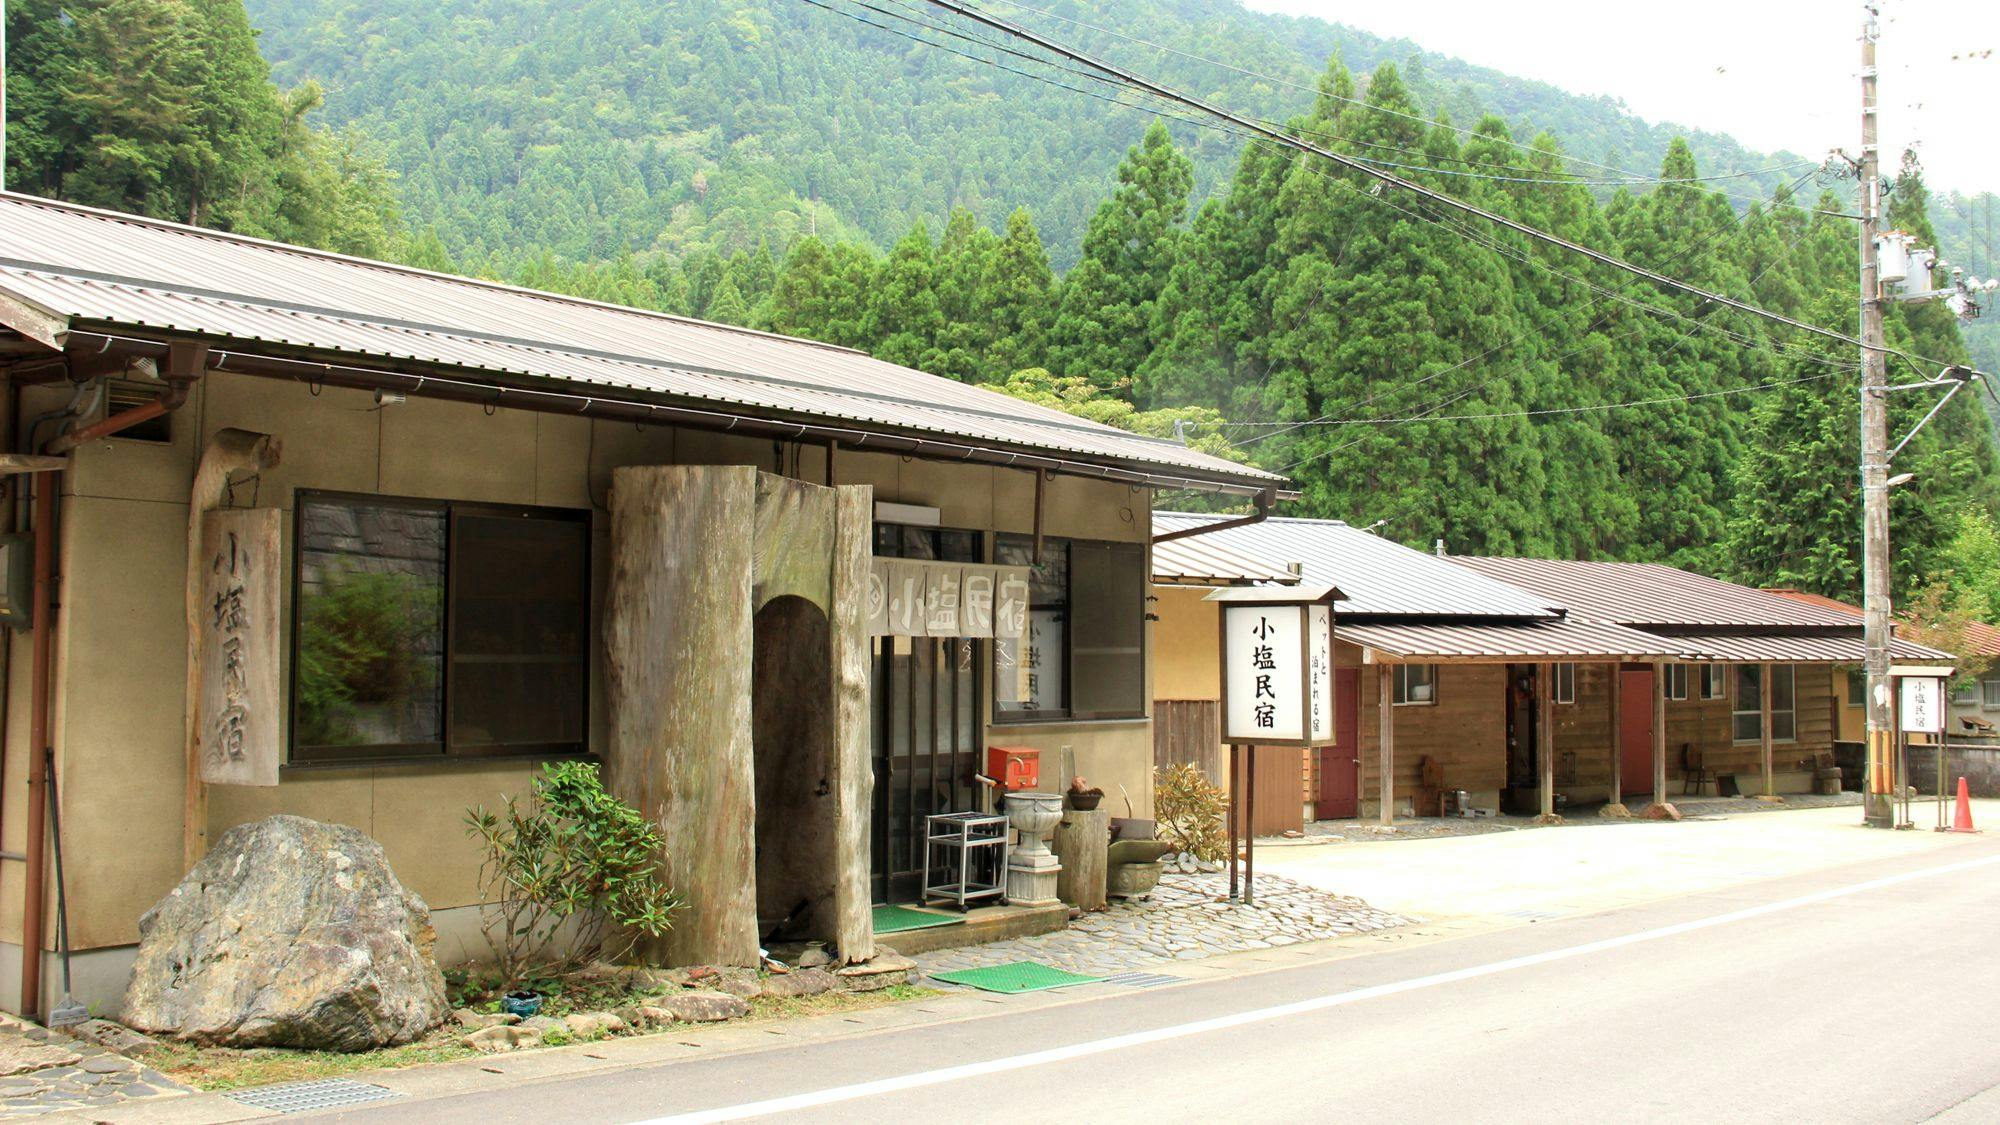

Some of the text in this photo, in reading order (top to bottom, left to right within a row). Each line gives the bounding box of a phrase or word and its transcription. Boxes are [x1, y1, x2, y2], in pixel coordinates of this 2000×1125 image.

[890, 573, 1029, 632] 小塩民宿
[214, 532, 251, 762] 小塩民宿
[1252, 616, 1277, 729] 小塩民宿
[1311, 655, 1321, 733] 泊まれる宿
[1914, 681, 1926, 728] 小塩民宿
